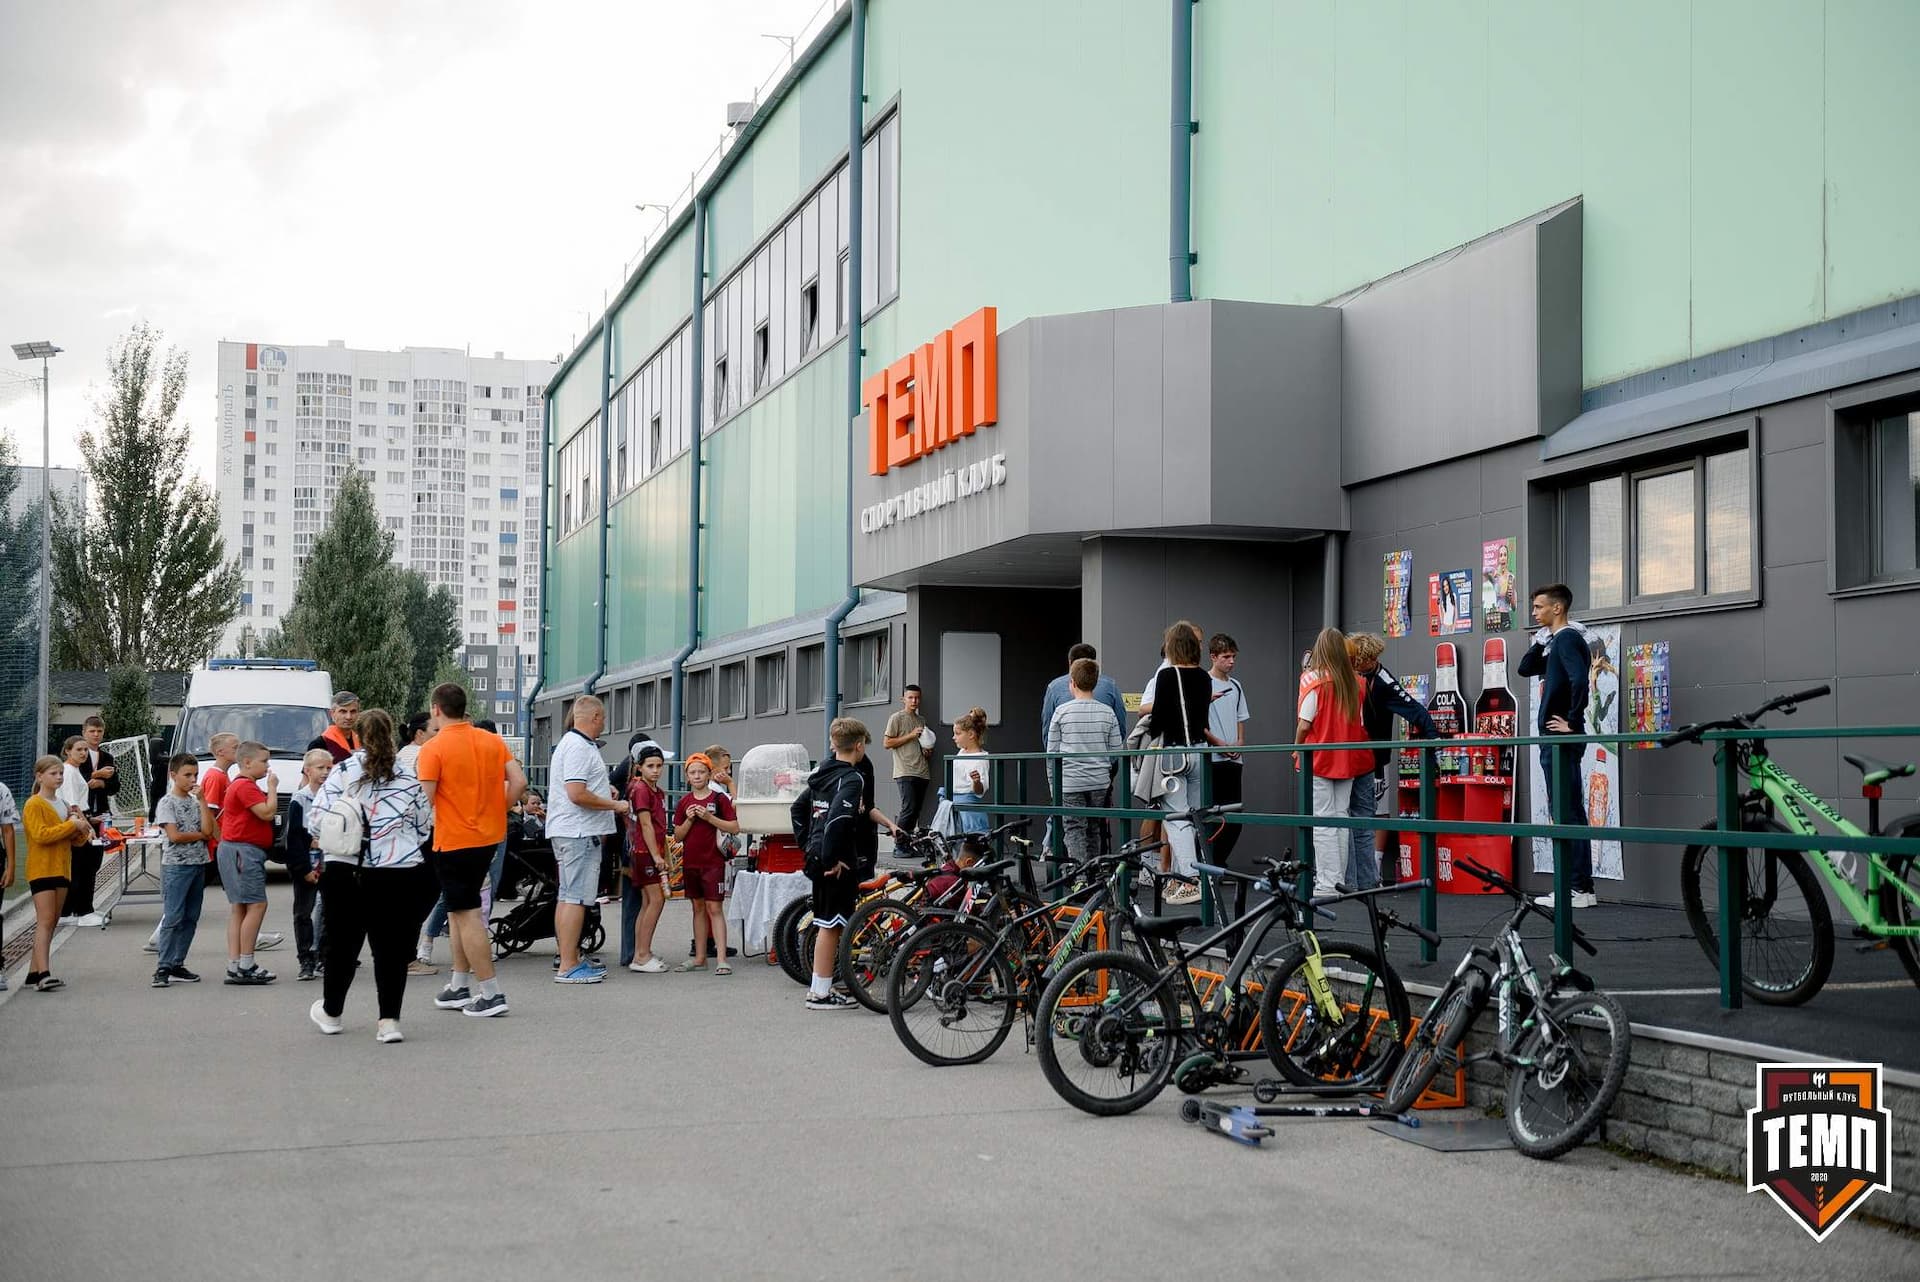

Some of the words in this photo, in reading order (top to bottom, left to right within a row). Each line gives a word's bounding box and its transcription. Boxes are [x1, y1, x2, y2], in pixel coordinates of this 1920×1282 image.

[863, 306, 998, 476] ТЕМП
[860, 467, 957, 534] СПОРТИВНЫЙ
[957, 452, 1008, 498] КЛУБ
[1436, 693, 1456, 706] COLA
[1484, 776, 1506, 784] COLA
